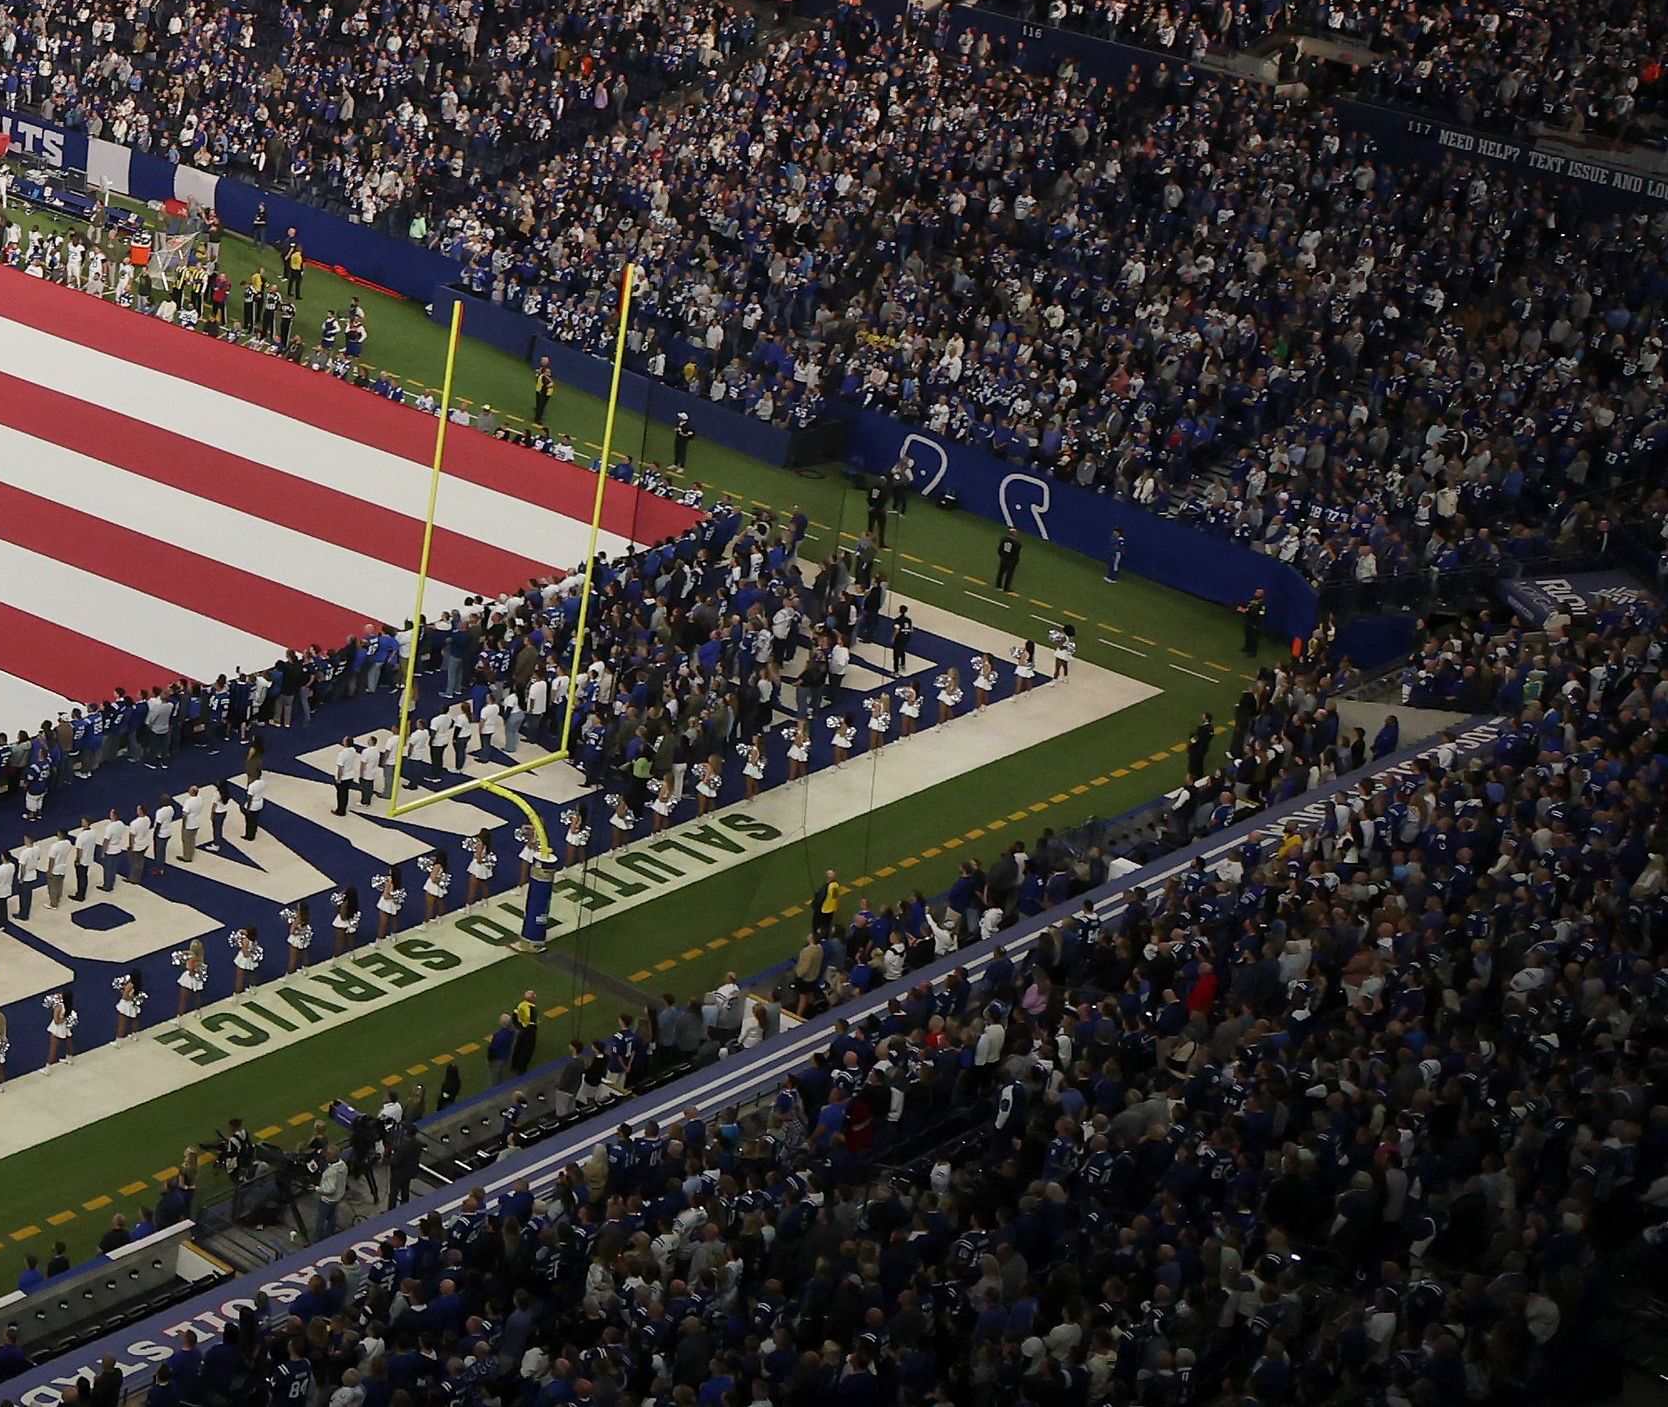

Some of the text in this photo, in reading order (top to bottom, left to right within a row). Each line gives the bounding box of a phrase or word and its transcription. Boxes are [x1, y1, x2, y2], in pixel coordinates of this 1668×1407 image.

[1022, 24, 1043, 39] 116
[1406, 119, 1433, 136] 117
[1437, 129, 1475, 152] NEED
[1477, 138, 1521, 162] HELP?
[1528, 150, 1565, 174] TEXT
[1567, 160, 1609, 185] ISSUE
[1611, 175, 1644, 194] AND
[553, 811, 784, 912] SALUTE
[153, 937, 463, 1067] SERVICE
[164, 1298, 258, 1345] OIL
